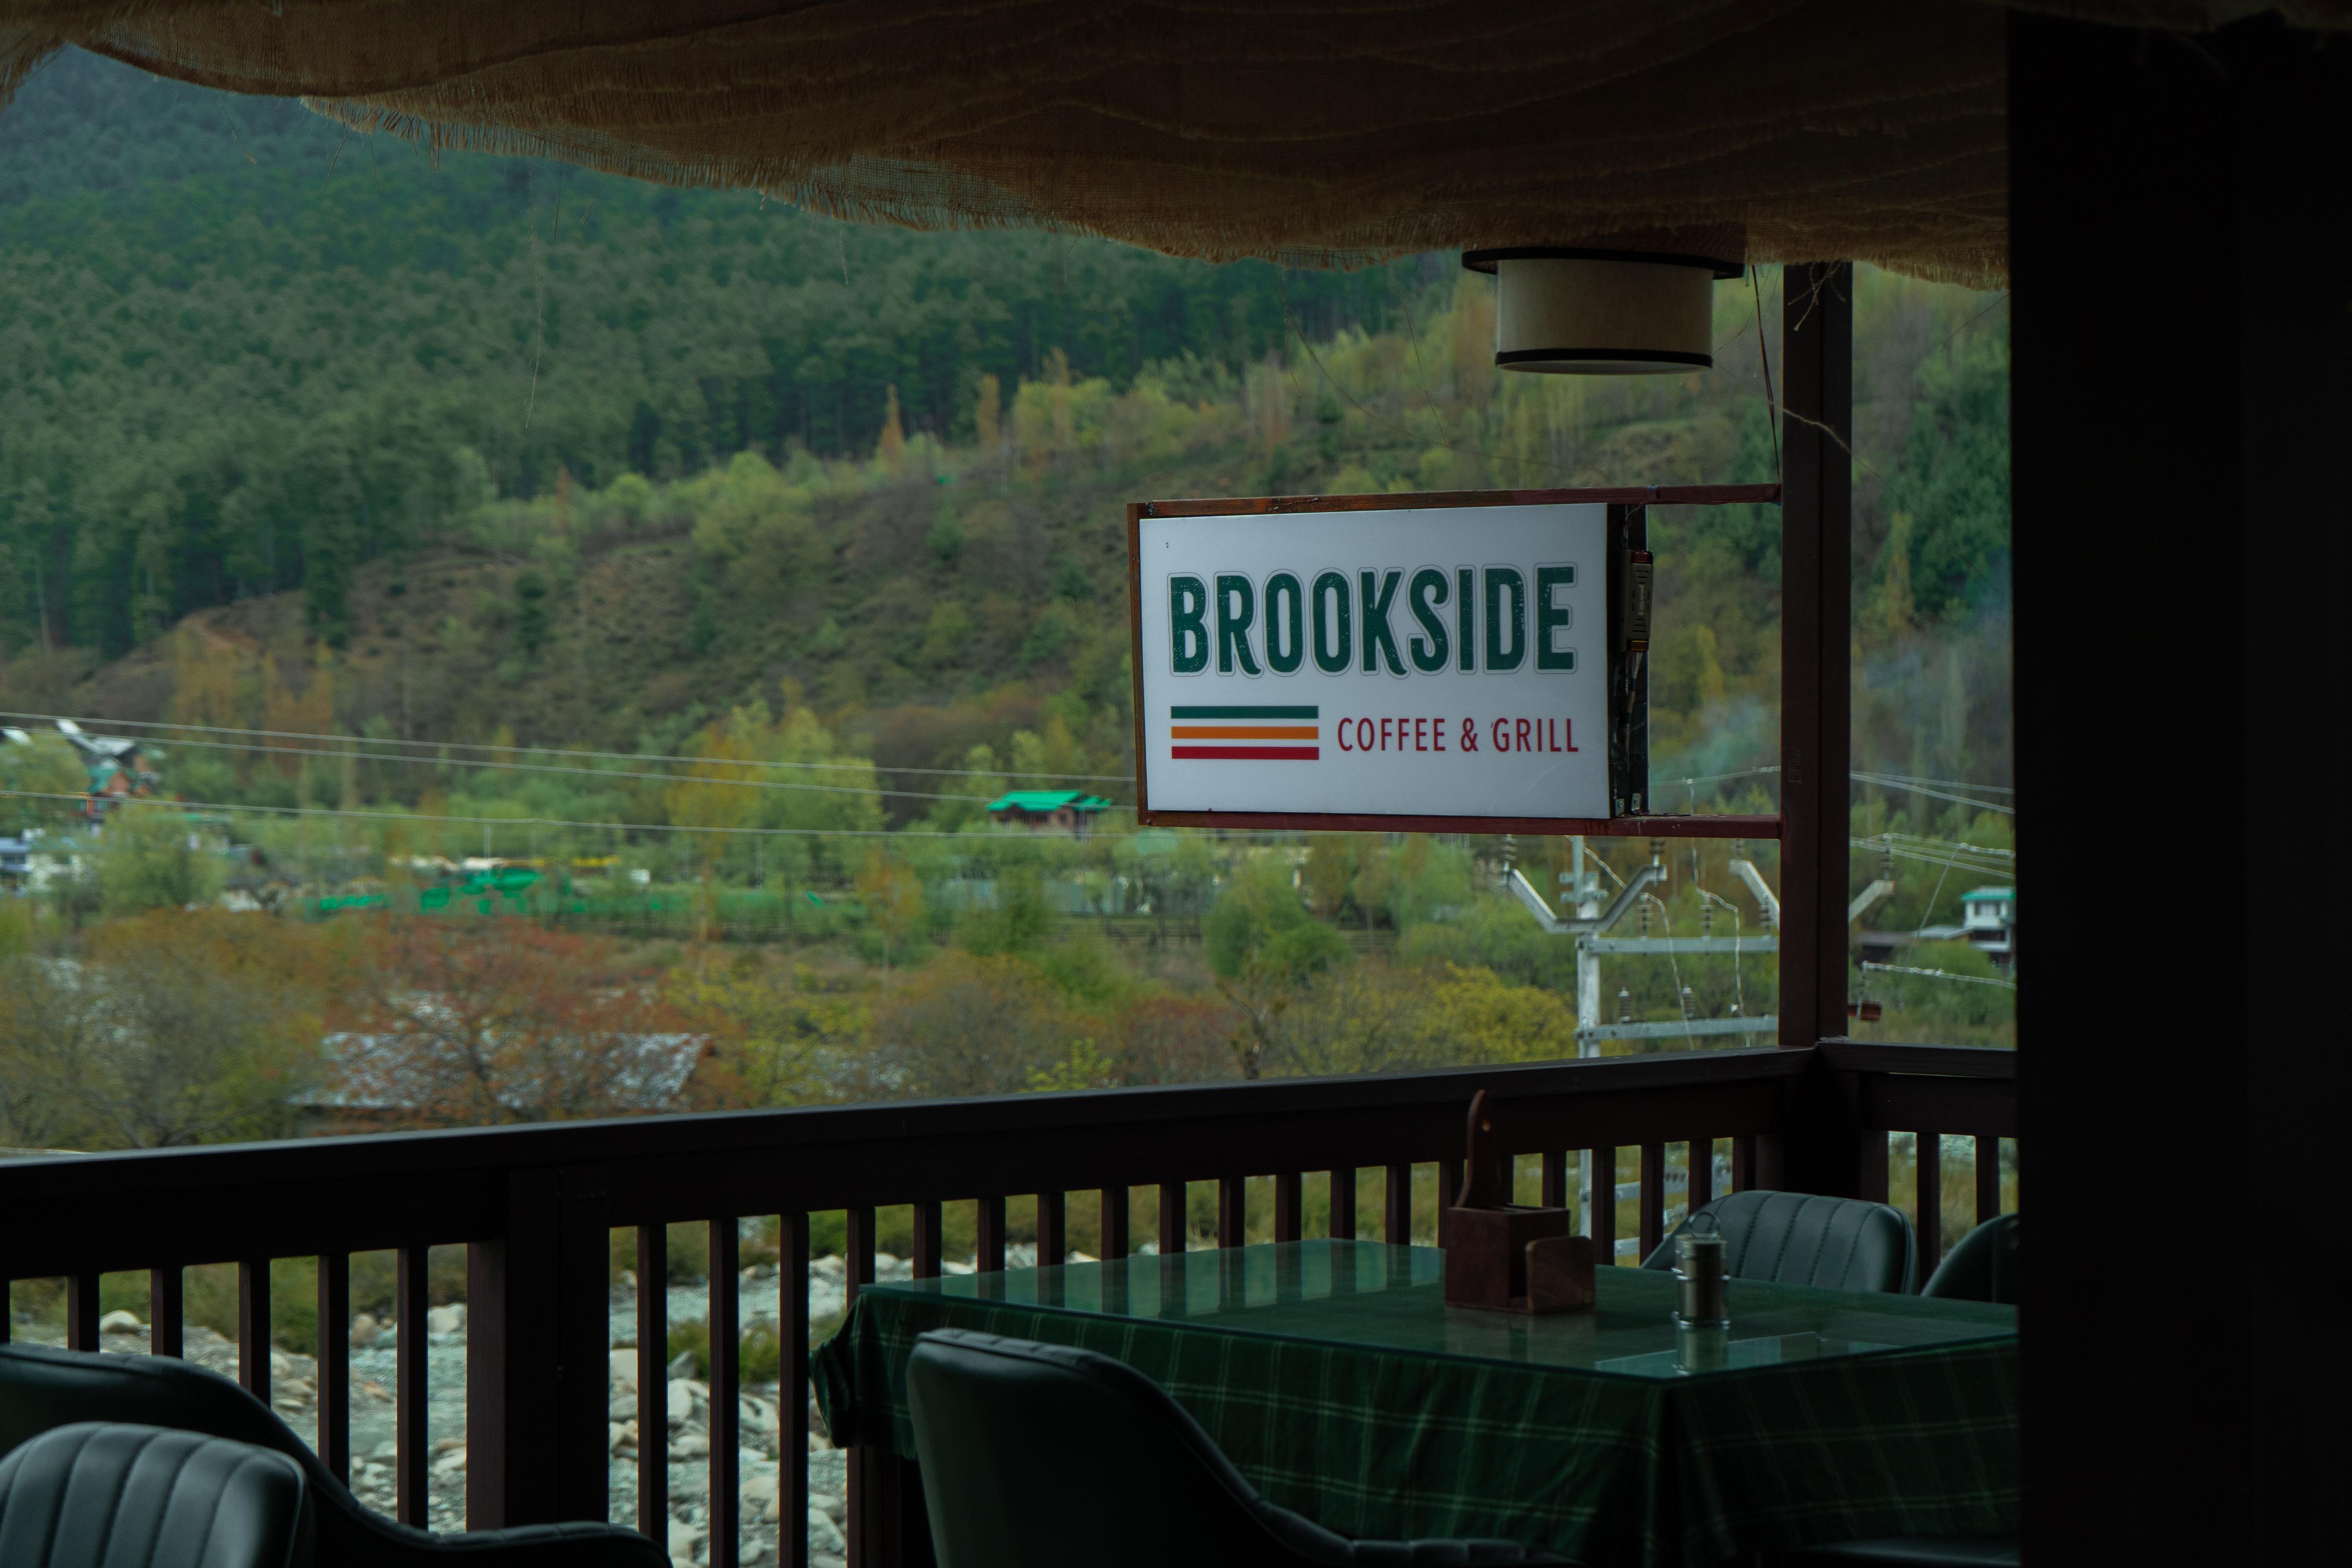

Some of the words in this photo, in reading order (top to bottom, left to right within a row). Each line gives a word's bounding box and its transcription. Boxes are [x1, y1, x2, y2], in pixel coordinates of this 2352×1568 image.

[1170, 566, 1575, 675] BROOKSIDE
[1338, 717, 1446, 751] COFFEE
[1460, 717, 1479, 752] &
[1493, 718, 1578, 752] GRILL
